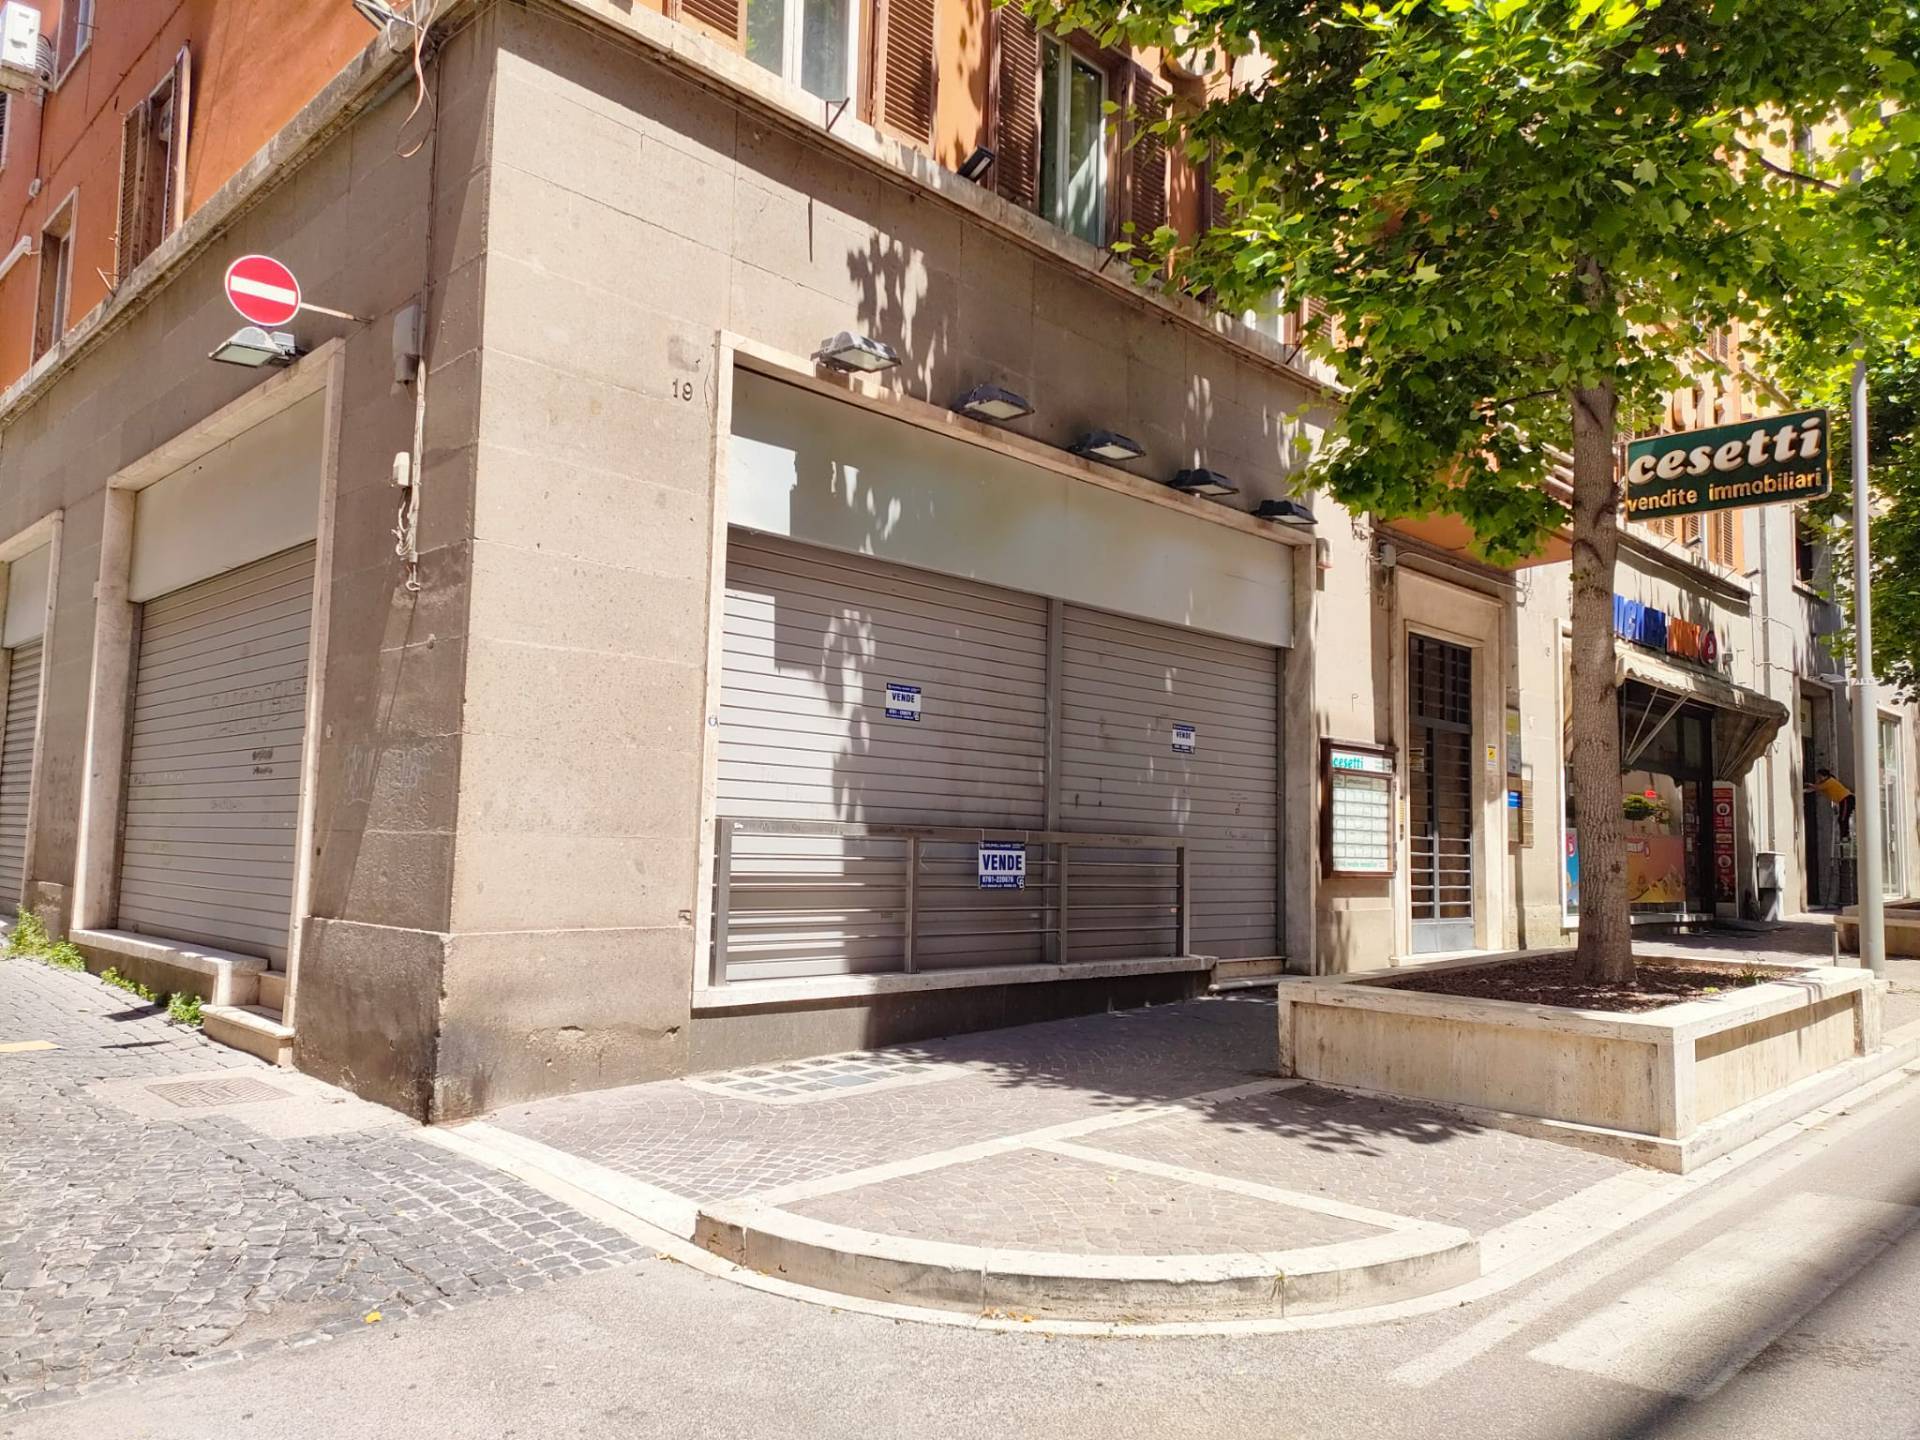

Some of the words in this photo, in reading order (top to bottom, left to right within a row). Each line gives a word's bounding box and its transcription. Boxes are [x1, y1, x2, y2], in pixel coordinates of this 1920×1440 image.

[672, 378, 693, 402] 19
[1628, 417, 1822, 485] cesetti
[1628, 488, 1698, 512] vendite
[1708, 467, 1822, 501] immobiliari
[892, 692, 915, 704] VENDE
[982, 854, 1023, 871] VENDE
